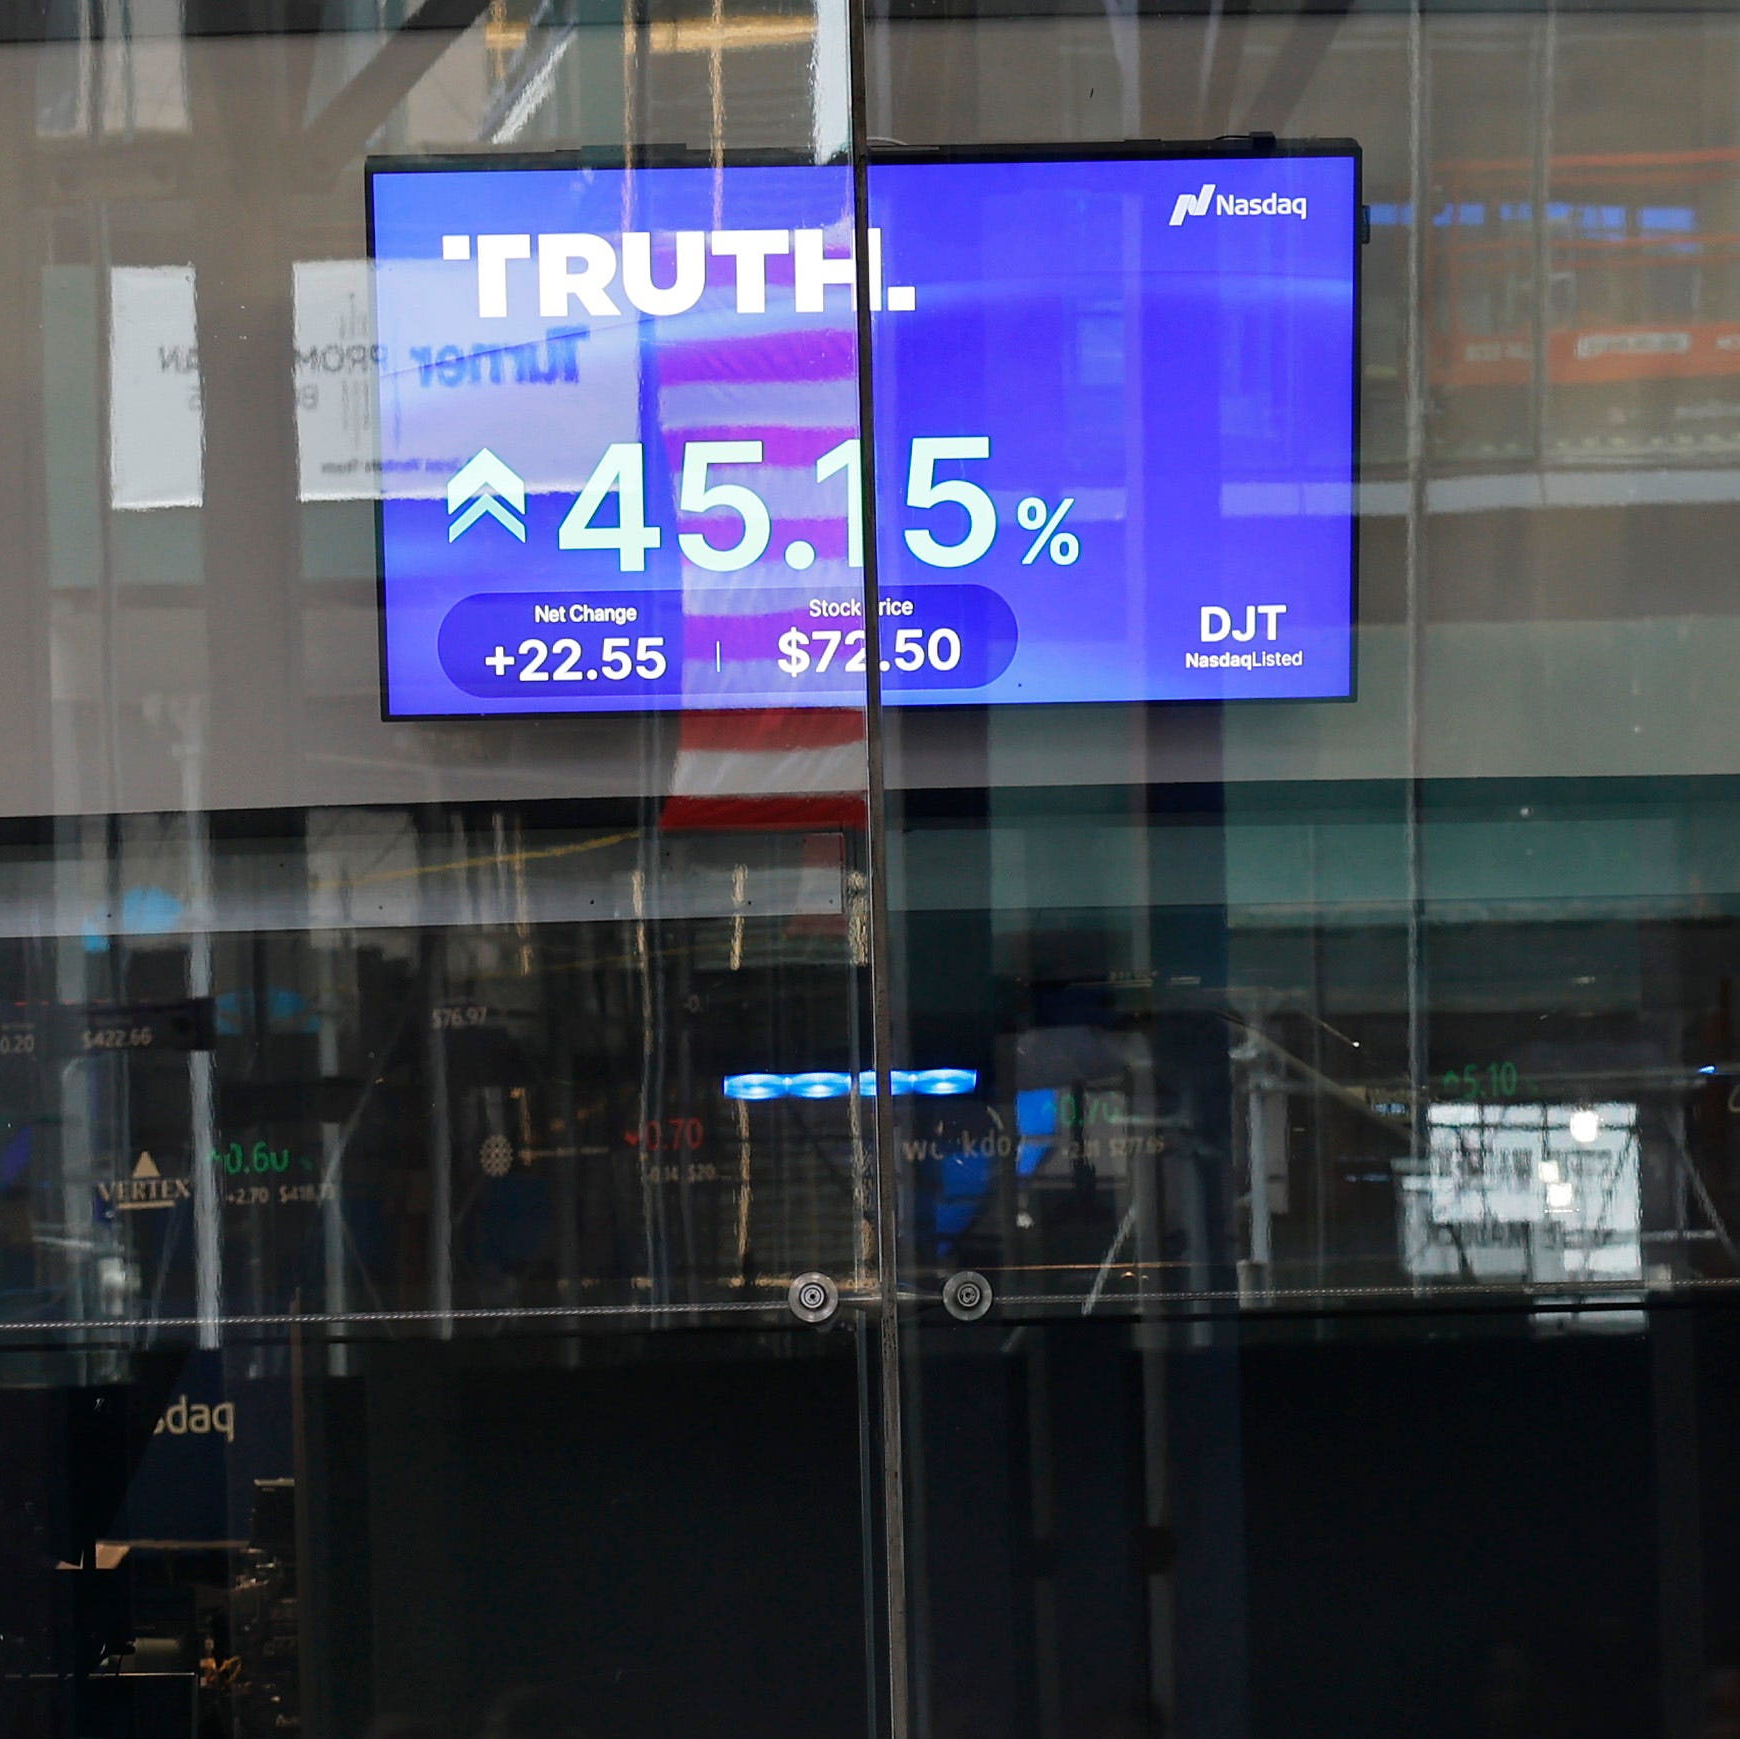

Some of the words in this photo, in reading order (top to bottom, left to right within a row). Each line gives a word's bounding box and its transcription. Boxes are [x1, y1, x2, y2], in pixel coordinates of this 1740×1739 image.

[1215, 192, 1307, 221] Nasdaq
[442, 228, 915, 319] TRUTH.
[557, 436, 1079, 574] 45.15%
[533, 603, 564, 622] Net
[568, 603, 637, 624] Change
[809, 598, 861, 618] Stock
[877, 598, 914, 617] rice
[1199, 606, 1287, 642] DJT
[483, 635, 666, 683] +22.55
[776, 626, 962, 678] $72.50
[1184, 649, 1304, 670] NasdaqListed
[97, 1178, 191, 1202] VERTEX
[154, 1394, 235, 1444] daq
